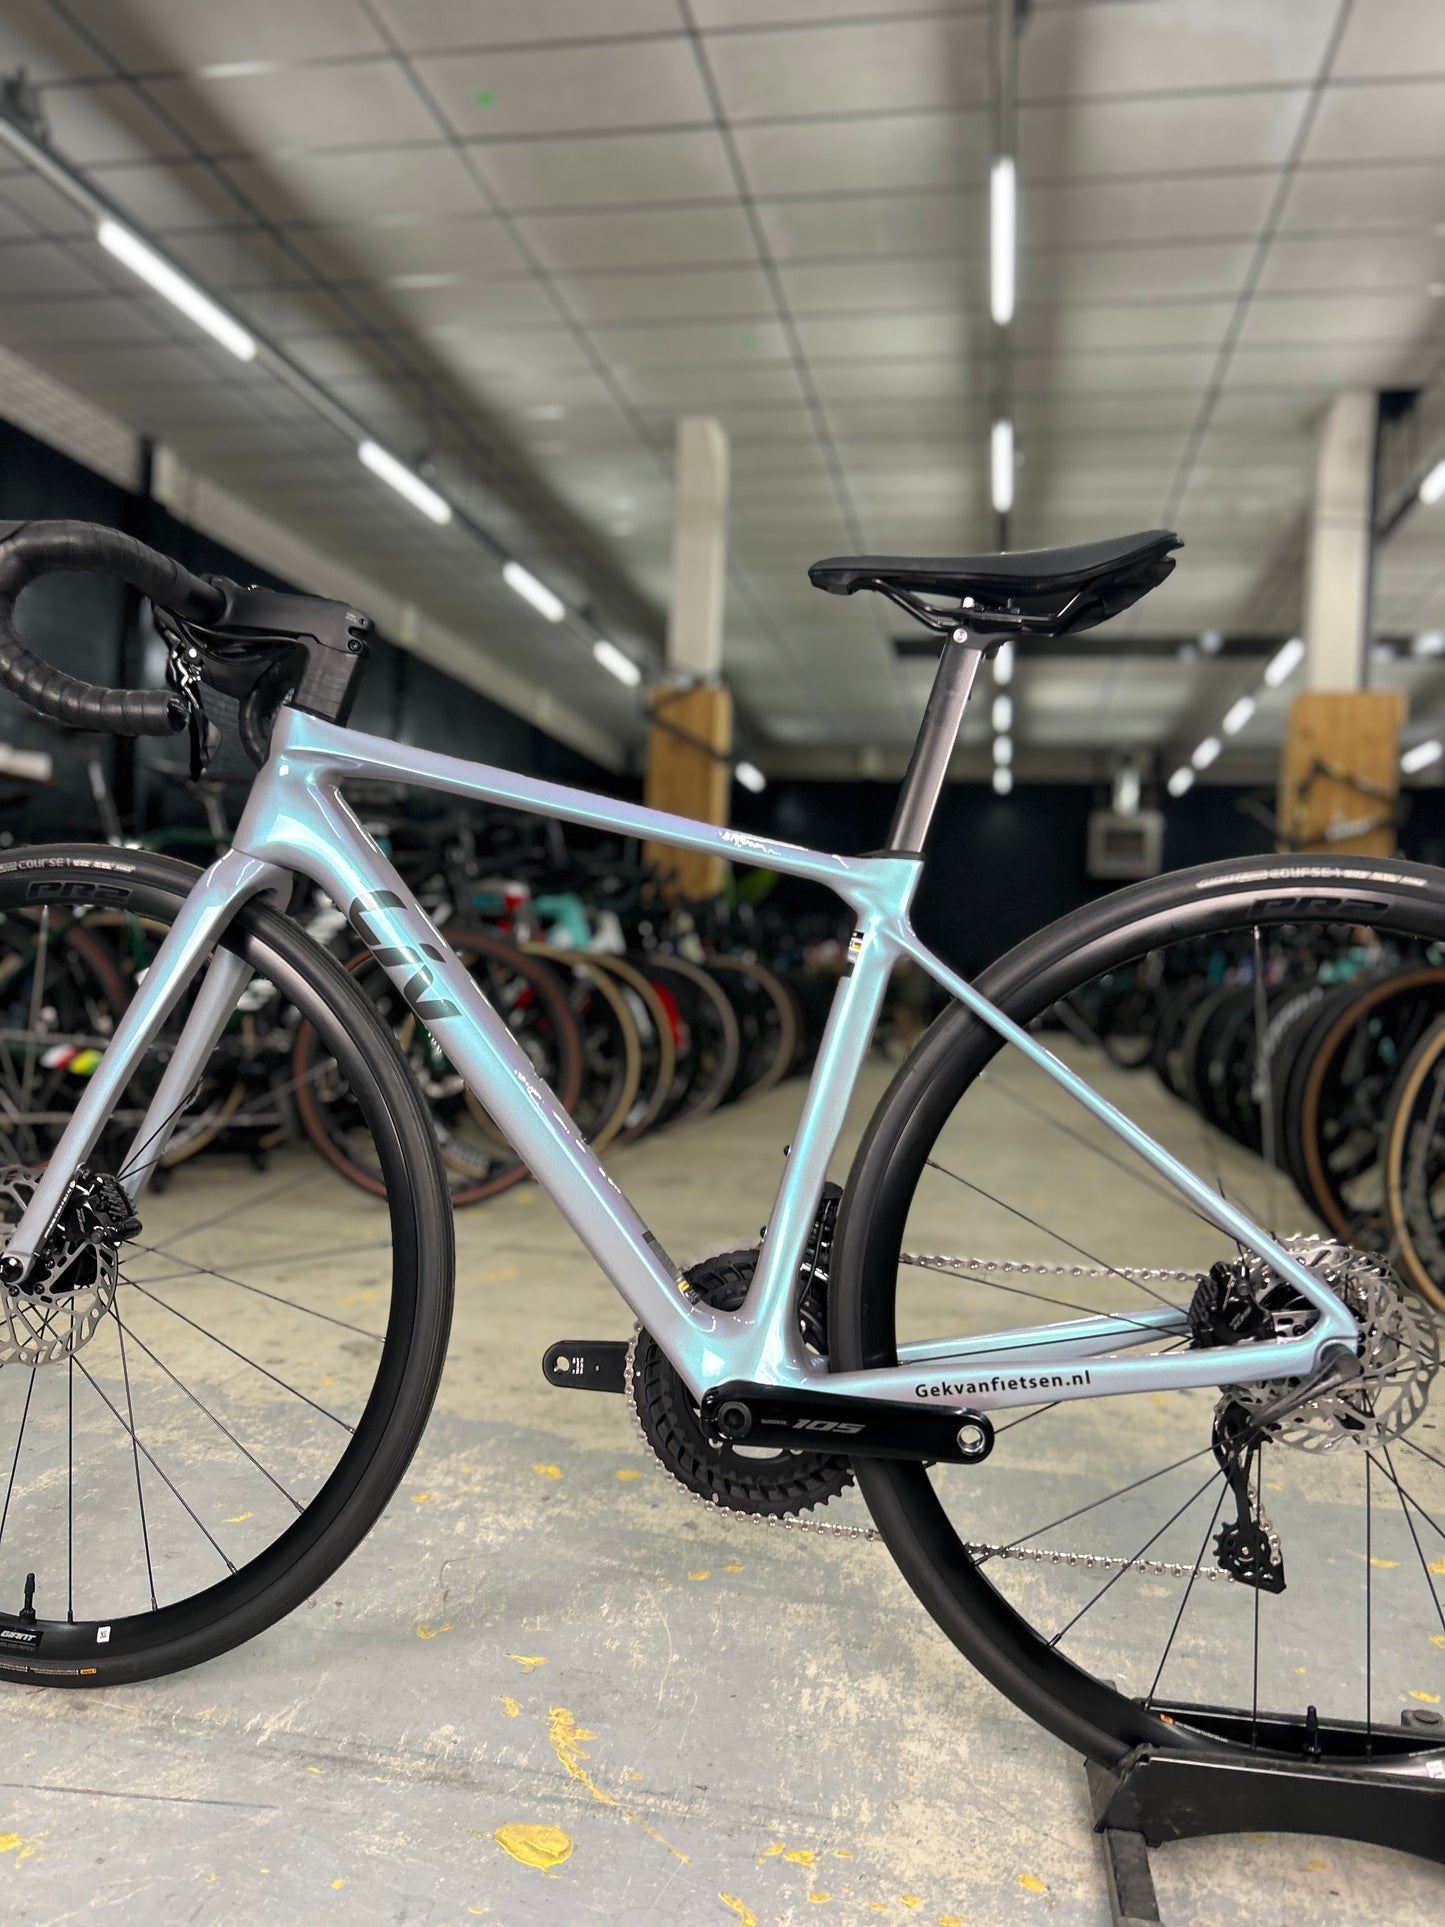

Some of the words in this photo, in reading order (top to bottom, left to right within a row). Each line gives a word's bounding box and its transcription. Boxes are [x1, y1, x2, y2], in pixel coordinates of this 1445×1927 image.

[26, 880, 134, 903] PR2
[915, 1370, 1091, 1398] Gekvanfietsen.nl
[792, 1419, 866, 1434] 105
[0, 1630, 37, 1642] GIANT
